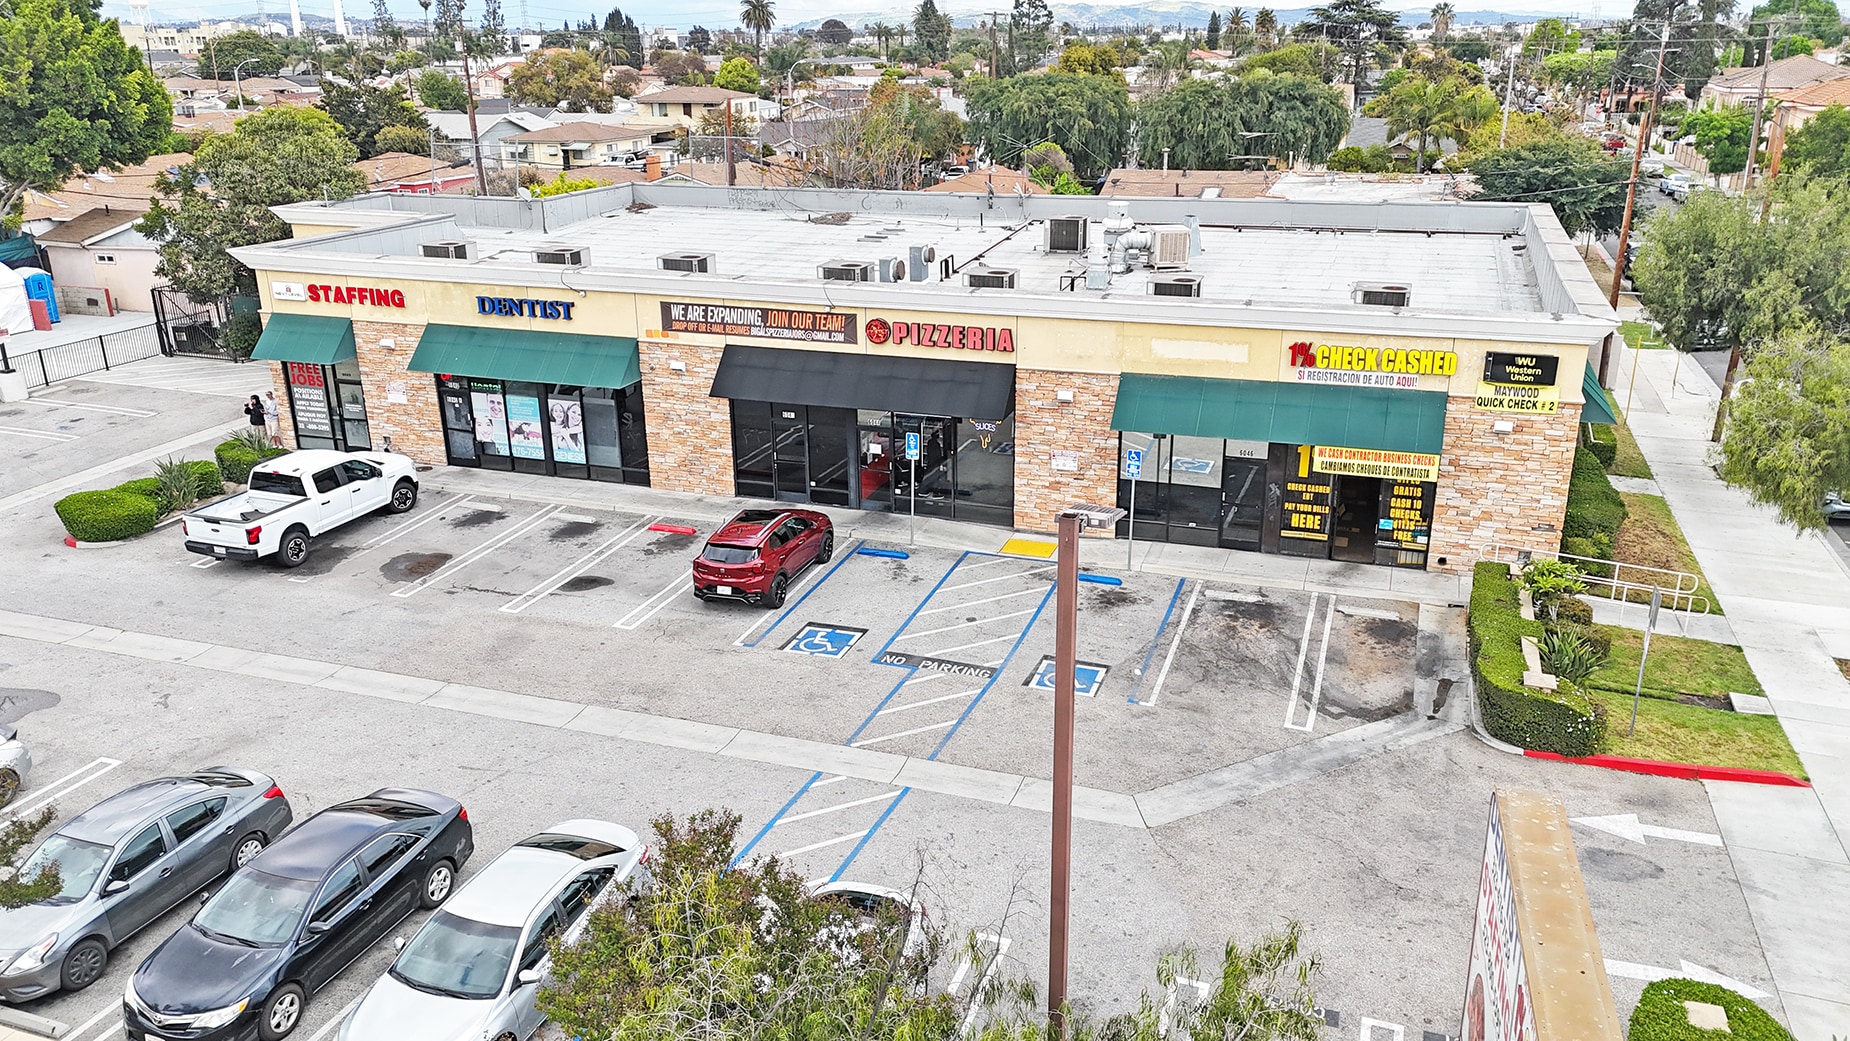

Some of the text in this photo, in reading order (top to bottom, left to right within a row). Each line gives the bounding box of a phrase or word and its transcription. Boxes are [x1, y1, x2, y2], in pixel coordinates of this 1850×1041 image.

[307, 284, 406, 308] STAFFING
[476, 296, 575, 320] DENTIST
[671, 304, 846, 331] WE ARE EXPANDING, JOIN OUR TEAM!
[672, 321, 687, 330] DROP
[687, 322, 698, 331] OFF
[698, 323, 707, 332] OR
[707, 323, 724, 333] E-MAIL
[725, 325, 750, 335] RESUMES
[892, 321, 1014, 352] PIZZERIA
[1288, 341, 1458, 376] 1% CHECK CASHED
[1515, 356, 1536, 366] WU
[290, 362, 320, 374] FREE
[1505, 365, 1542, 375] Western
[290, 373, 323, 387] JOBS
[1307, 371, 1361, 384] REGISTRACION
[1362, 375, 1372, 385] DE
[1374, 376, 1395, 386] AUTO
[1510, 373, 1534, 382] Union
[1494, 385, 1540, 398] MAYWOOD
[1476, 396, 1505, 408] QUICK
[1507, 398, 1538, 410] CHECK
[1549, 401, 1555, 410] 2
[975, 422, 997, 431] SLICES
[1318, 447, 1436, 466] WE CASH CONTRACTOR BUSINESS CHECKS
[1321, 460, 1430, 479] CAMBIAMOS CHEQUES DE CONTRATISTA
[1287, 482, 1331, 494] CHECK CASHED
[1393, 485, 1422, 497] GRATIS
[1284, 502, 1330, 514] PAY YOUR BILLS
[1390, 497, 1422, 509] CASH 10
[1291, 513, 1321, 529] HERE
[1390, 508, 1420, 520] CHECKS
[1393, 530, 1412, 541] FREE
[880, 654, 992, 678] NO PARKING
[1482, 862, 1510, 1041] STAFFING
